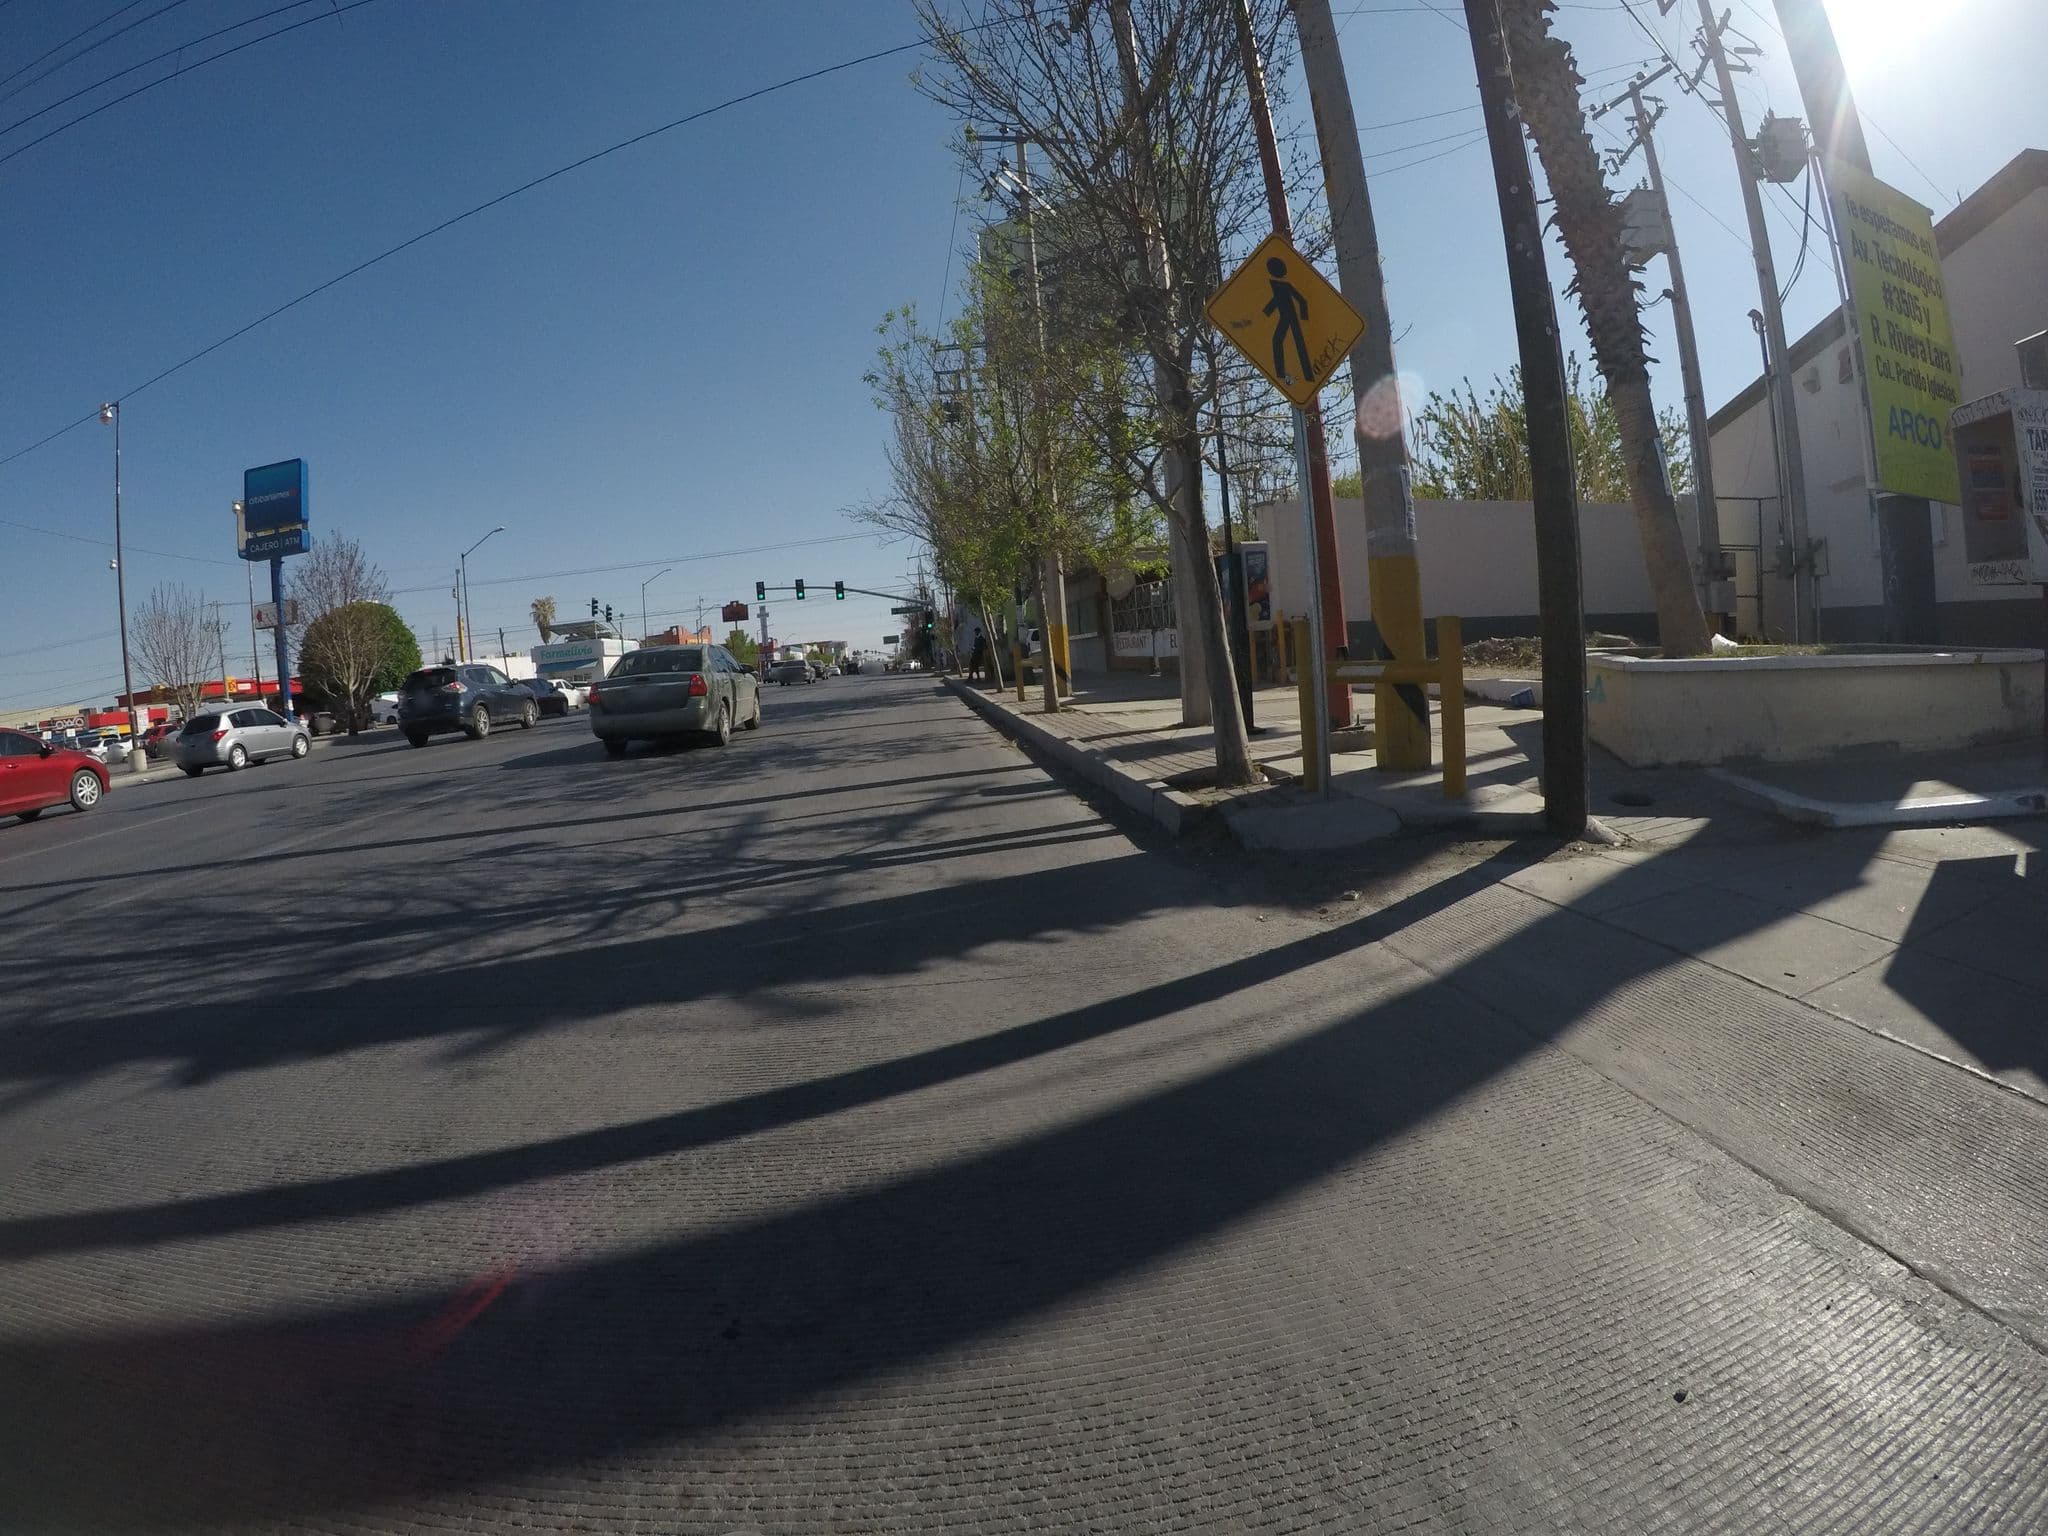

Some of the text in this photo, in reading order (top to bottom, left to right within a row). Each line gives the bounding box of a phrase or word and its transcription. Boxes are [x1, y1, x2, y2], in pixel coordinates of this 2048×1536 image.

[1851, 228, 1874, 266] Av.
[1860, 205, 1920, 251] esperamos
[1871, 312, 1952, 373] R. Rivera Lara
[1895, 362, 1927, 392] Partido
[1888, 405, 1942, 449] ARCO
[250, 540, 279, 552] CAJERO
[540, 645, 593, 660] Farmalivio
